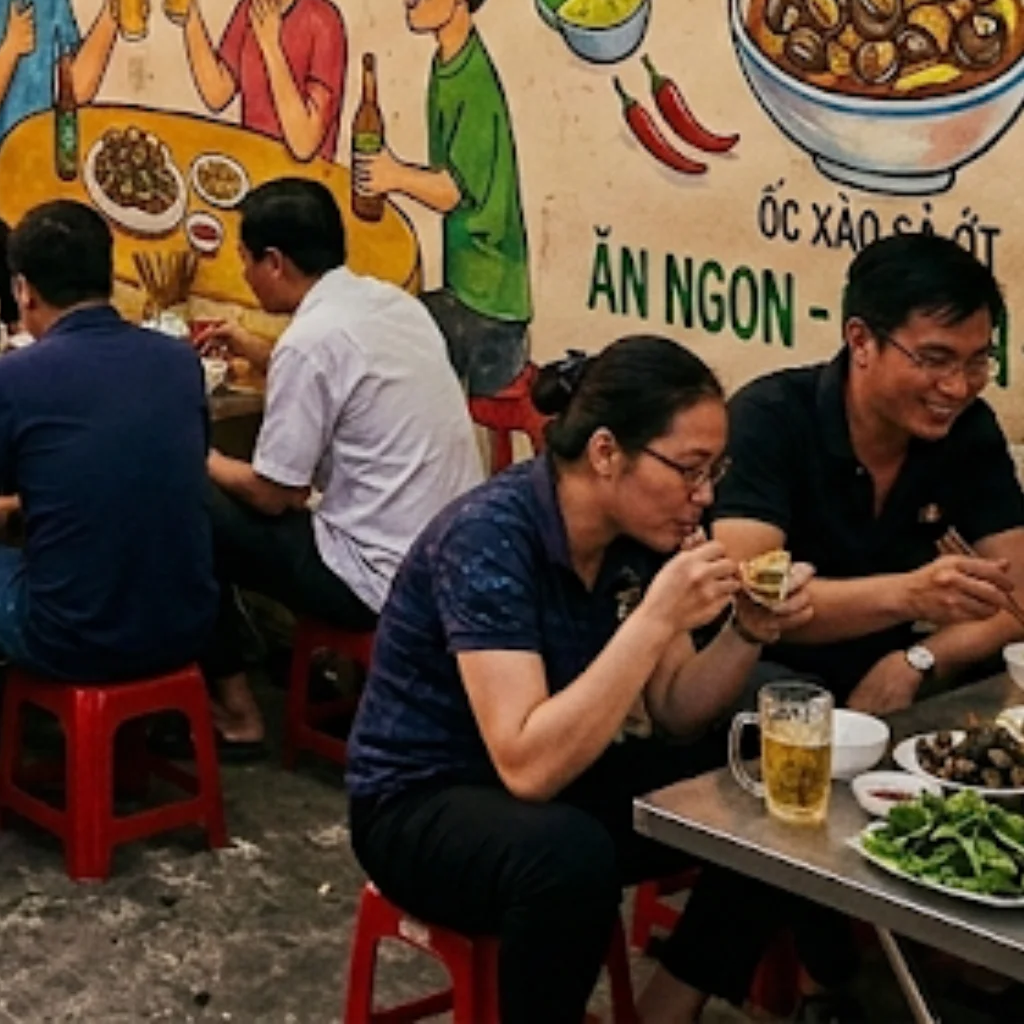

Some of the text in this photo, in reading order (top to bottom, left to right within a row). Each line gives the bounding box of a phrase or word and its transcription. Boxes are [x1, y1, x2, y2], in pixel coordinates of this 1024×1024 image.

[759, 179, 801, 243] ỐC
[587, 225, 649, 320] ĂN
[664, 252, 794, 348] NGON
